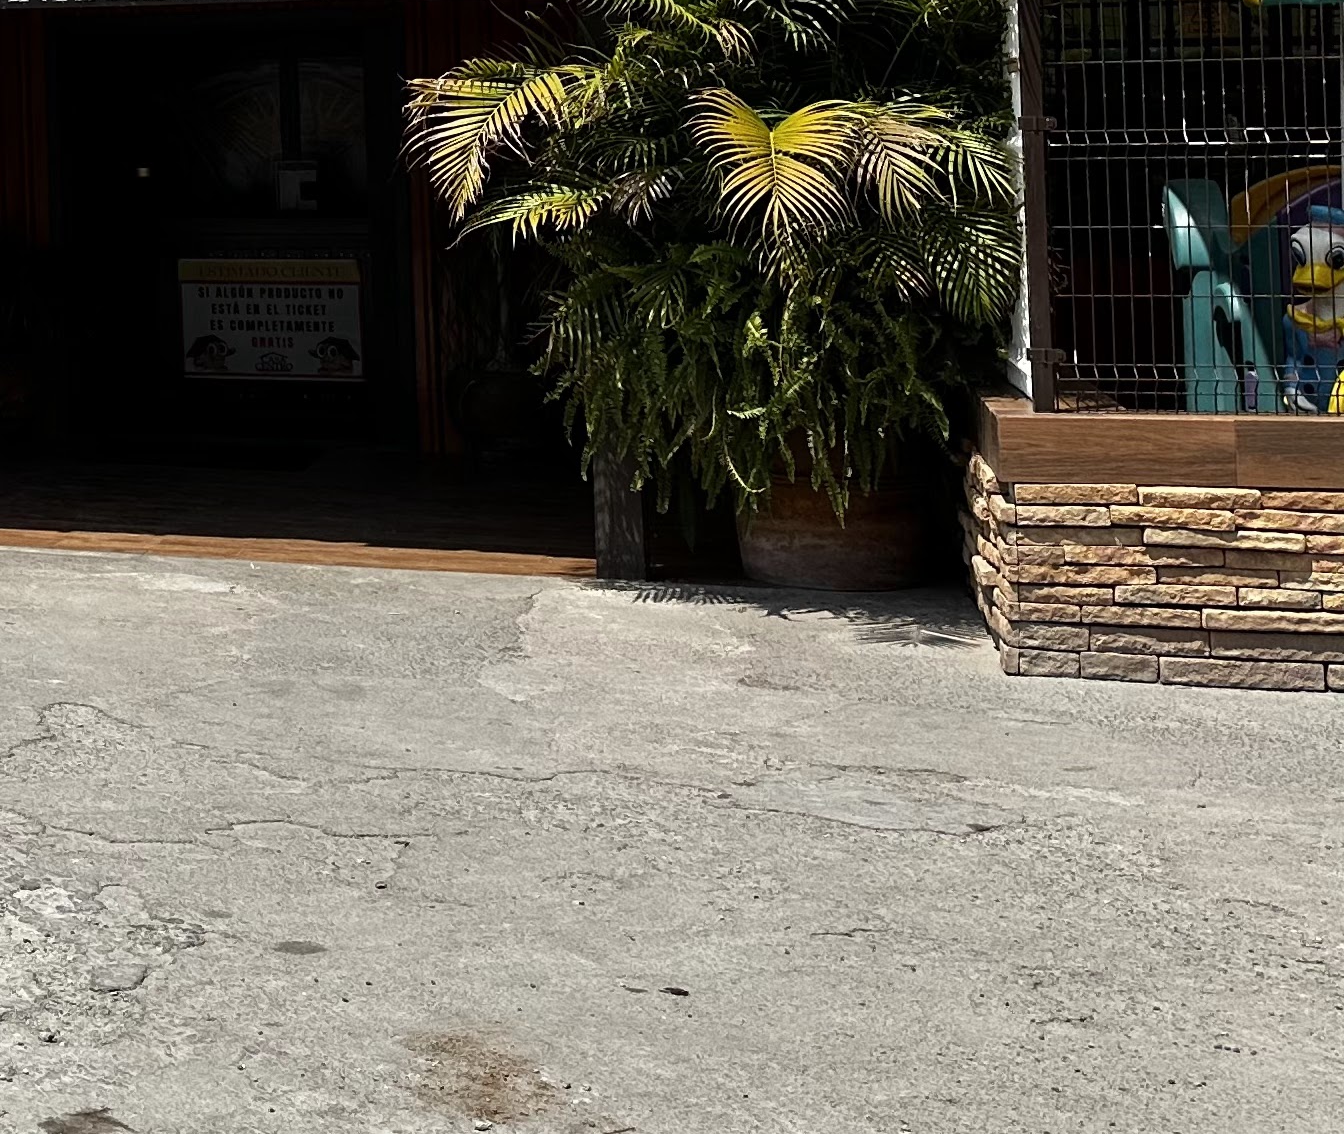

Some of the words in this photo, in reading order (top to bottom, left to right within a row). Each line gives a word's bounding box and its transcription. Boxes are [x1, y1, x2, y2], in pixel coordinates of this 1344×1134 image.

[197, 287, 210, 299] SI
[215, 285, 254, 299] ALGÚN
[259, 287, 323, 300] PRODUCTO
[328, 288, 344, 300] NO
[211, 301, 240, 315] ESTÁ
[245, 304, 261, 315] EN
[266, 304, 280, 315] EL
[285, 304, 327, 316] TICKET
[210, 319, 224, 331] ES
[229, 319, 335, 333] COMPLETAMENTE
[251, 336, 294, 348] GRATIS
